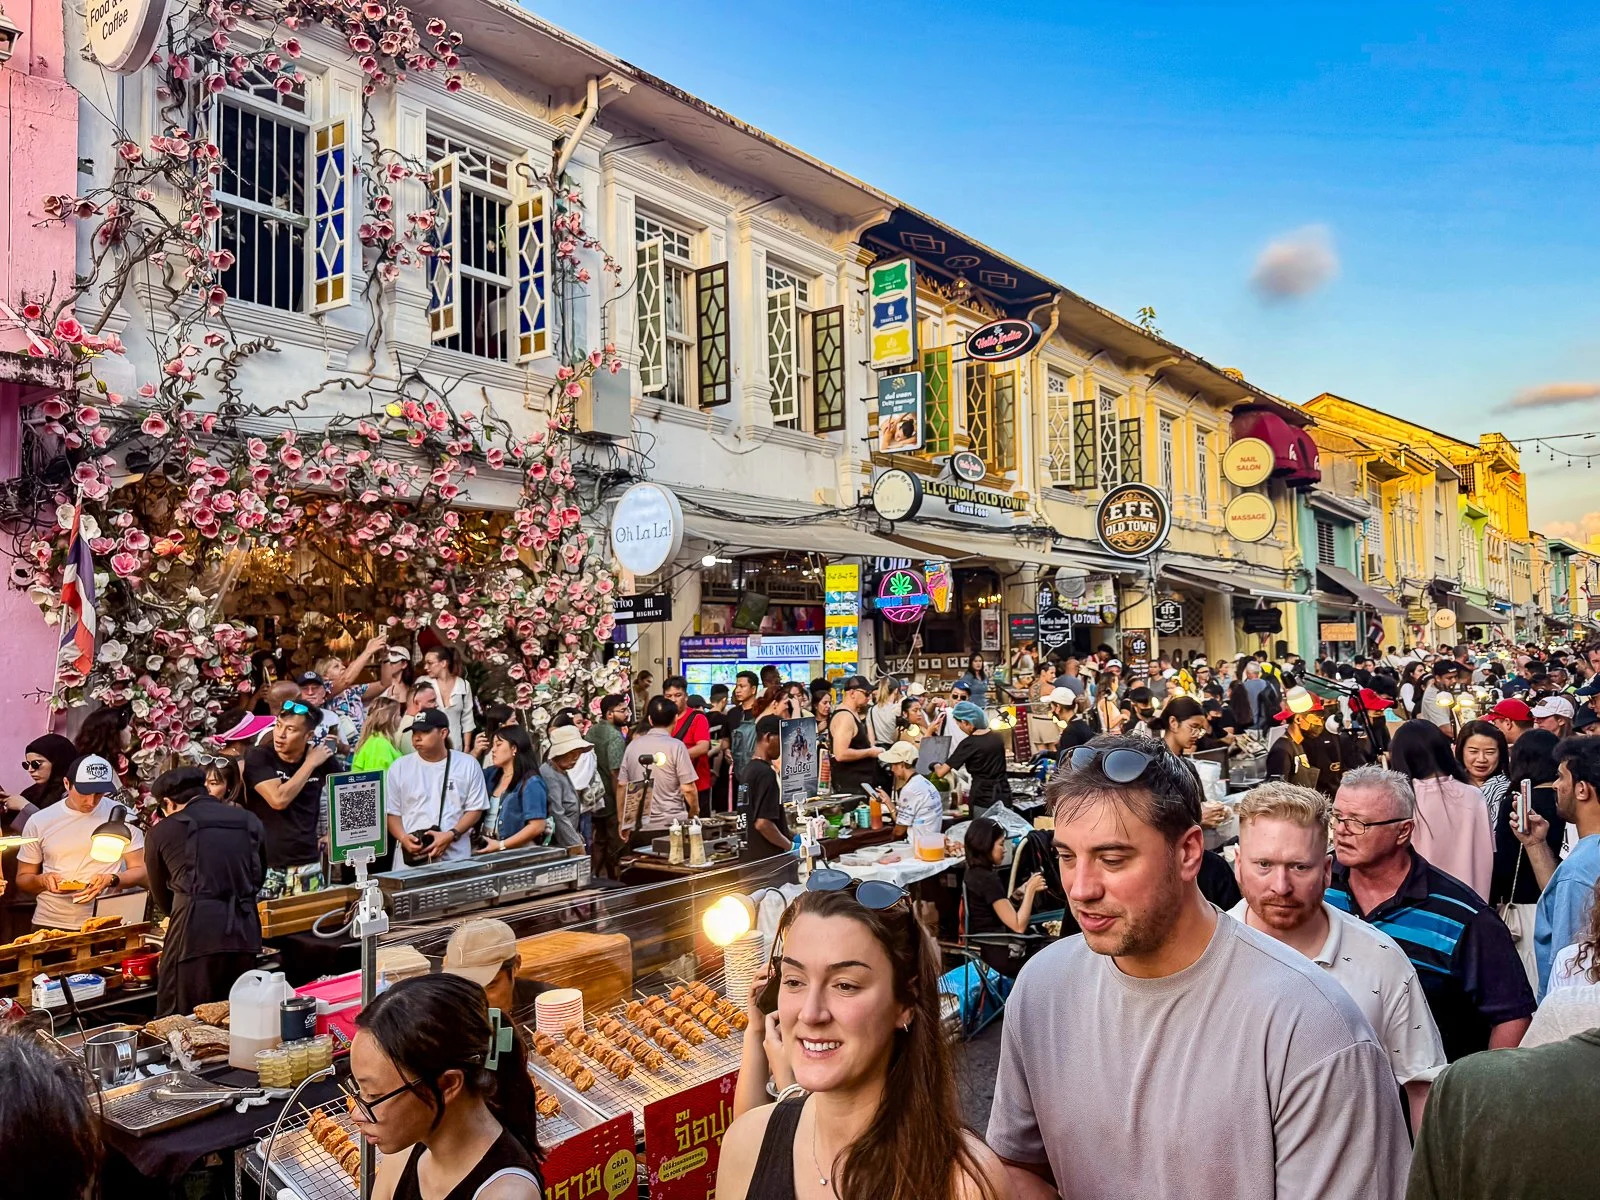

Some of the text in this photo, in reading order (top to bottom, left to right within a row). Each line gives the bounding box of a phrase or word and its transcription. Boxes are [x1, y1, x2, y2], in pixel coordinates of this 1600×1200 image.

[91, 0, 110, 27] Food
[102, 8, 129, 40] Coffee
[975, 329, 1023, 349] Hello India
[1236, 464, 1261, 472] SALON
[921, 481, 947, 496] ELLO
[949, 486, 977, 502] INDIA
[978, 491, 998, 506] OLD
[999, 496, 1027, 511] TOWN
[954, 503, 989, 517] INDIAN FOOD
[1109, 501, 1154, 521] EFE
[1231, 513, 1267, 521] MASSAGE
[615, 519, 672, 543] Oh La La!
[1105, 520, 1157, 537] OLD TOWN
[636, 609, 663, 618] HIGHEST
[1160, 602, 1176, 615] EFE
[1041, 616, 1054, 625] Hello
[757, 645, 774, 656] TOUR
[775, 643, 820, 656] INFORMATION
[611, 1156, 629, 1170] CRAB
[613, 1168, 627, 1180] MEAT
[611, 1177, 630, 1192] INSIDE
